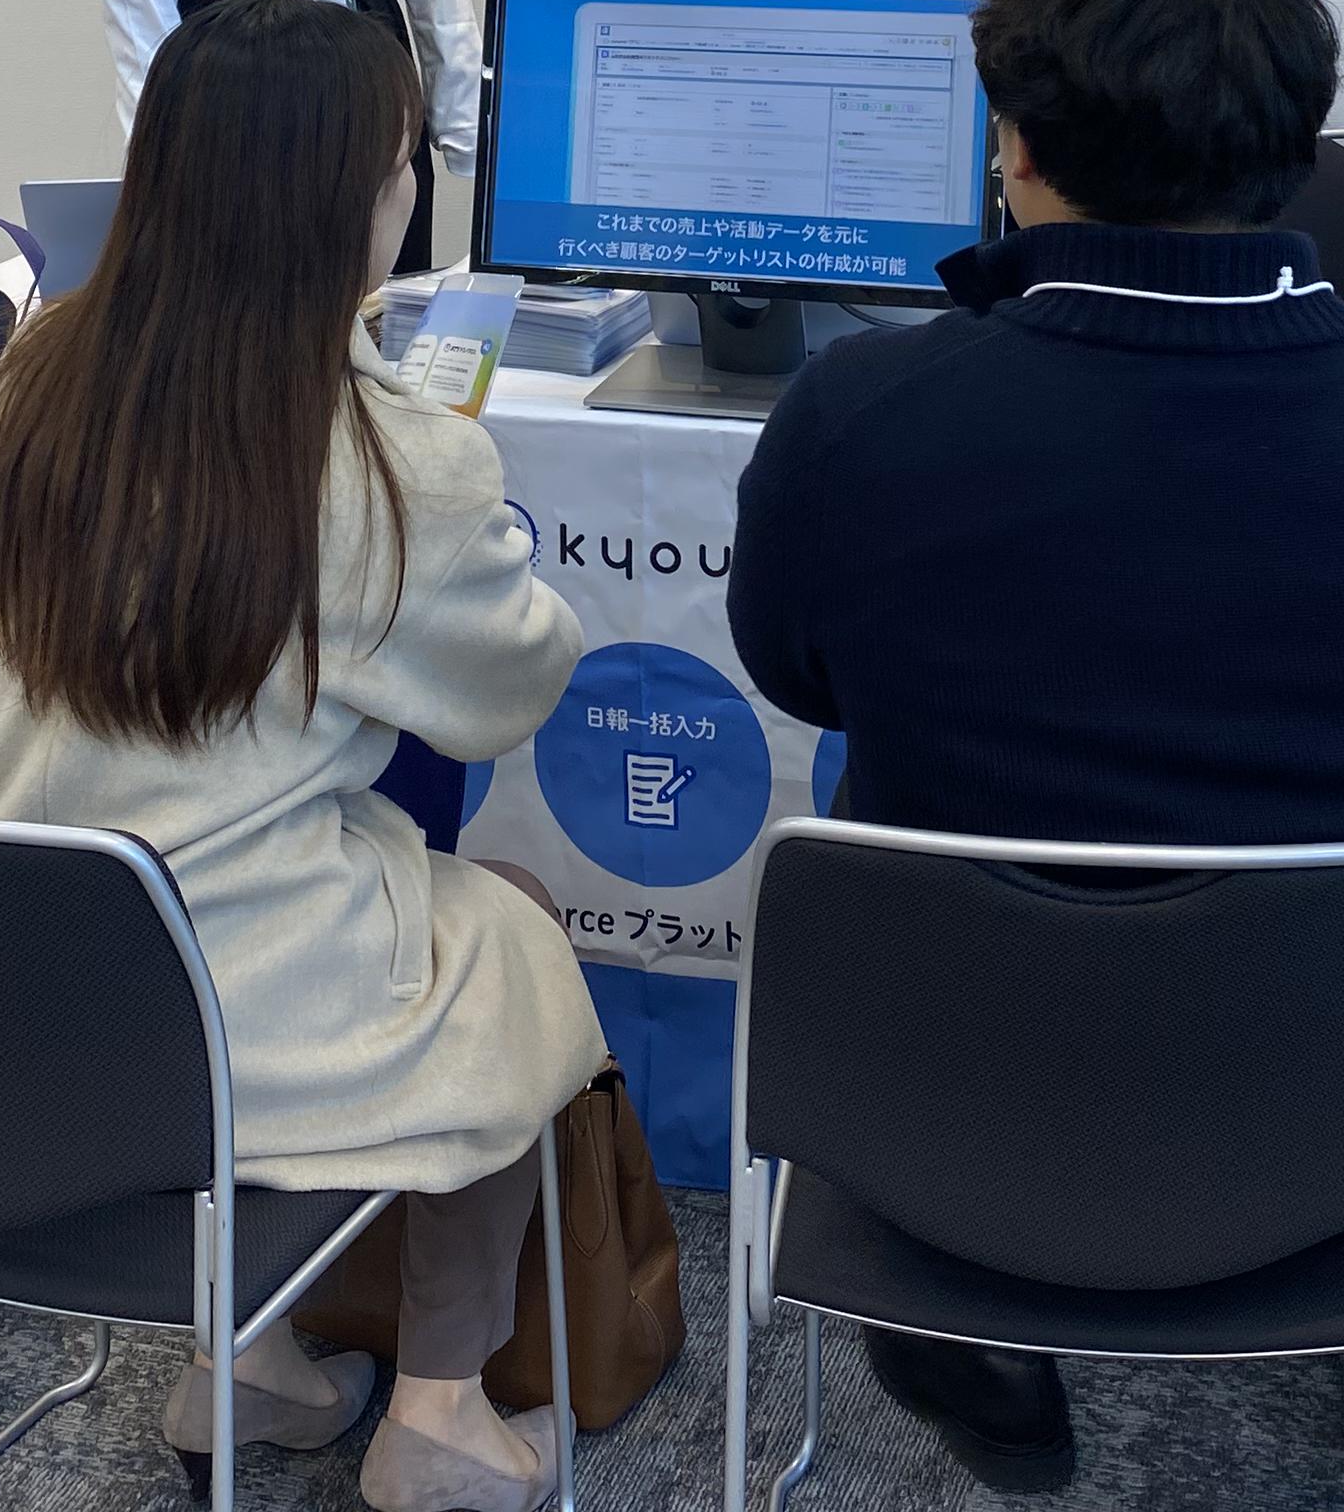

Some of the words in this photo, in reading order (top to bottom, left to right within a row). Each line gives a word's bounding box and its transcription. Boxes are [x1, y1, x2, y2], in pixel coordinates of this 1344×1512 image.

[596, 212, 869, 246] これまでの売上や活動データを元に
[558, 238, 907, 277] 行くべき顧客のターゲットリストの作成が可能
[710, 280, 741, 293] DELL
[587, 706, 717, 741] 日報一括入力
